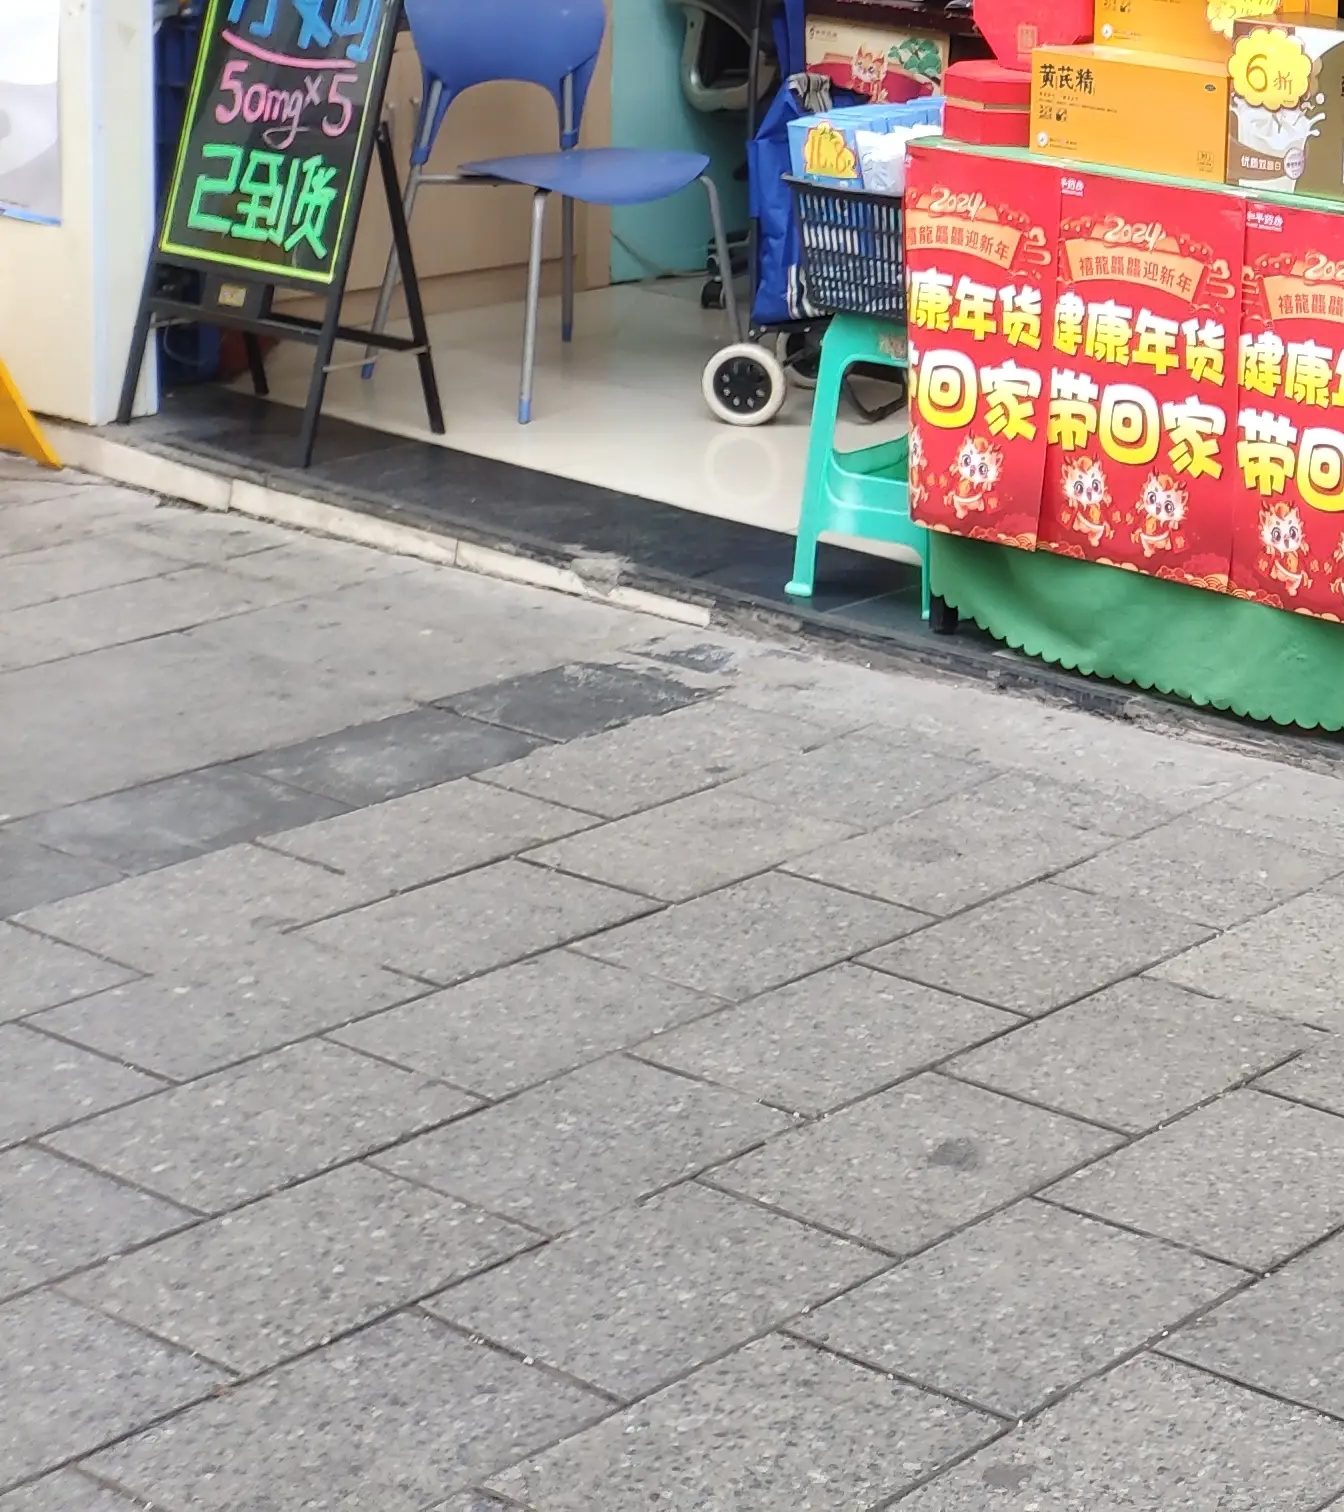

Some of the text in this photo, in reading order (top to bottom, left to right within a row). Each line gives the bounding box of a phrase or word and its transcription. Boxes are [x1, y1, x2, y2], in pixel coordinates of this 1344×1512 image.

[1039, 62, 1095, 96] 黄芪精
[1246, 53, 1293, 95] 6折
[1241, 156, 1282, 172] 优质双蛋白
[187, 142, 338, 260] 已到货
[928, 186, 988, 221] 2024
[1246, 212, 1284, 228] 和平药房
[1102, 216, 1163, 250] 2024
[1052, 289, 1227, 388] 健康年货
[909, 345, 1042, 443] 回家
[1047, 365, 1227, 481] 带回家
